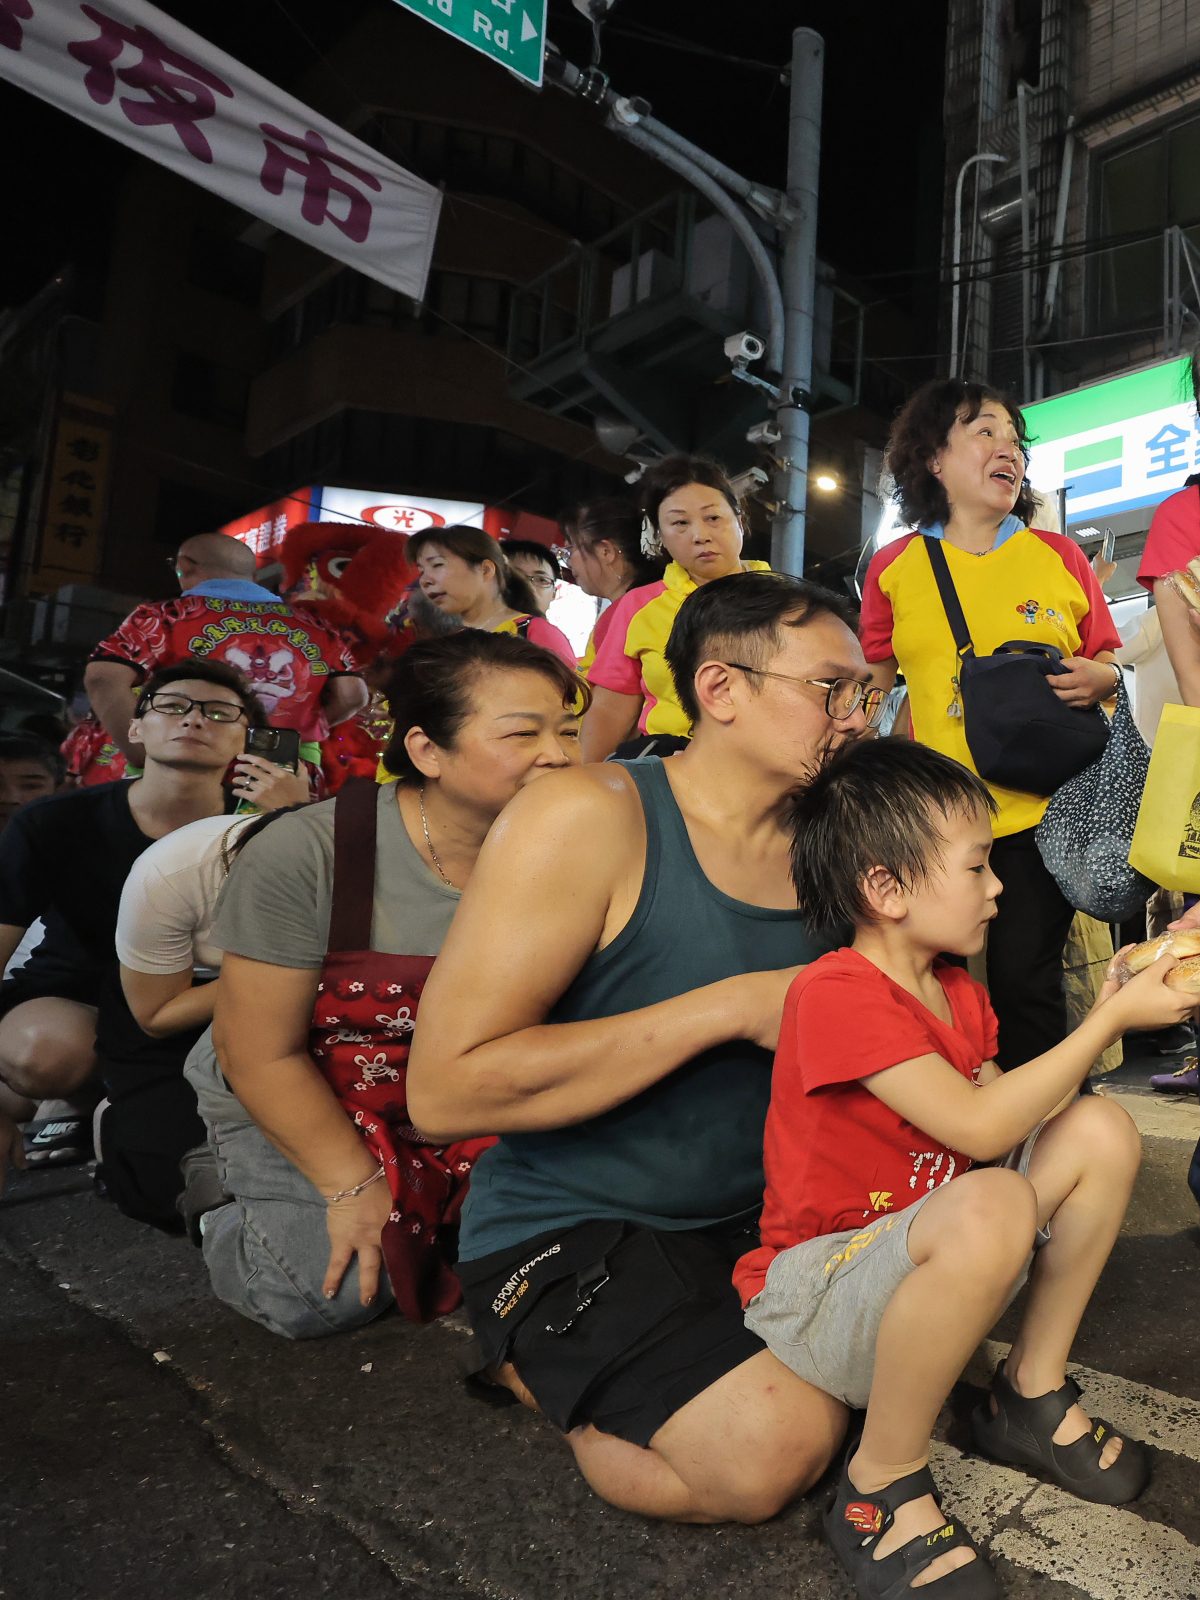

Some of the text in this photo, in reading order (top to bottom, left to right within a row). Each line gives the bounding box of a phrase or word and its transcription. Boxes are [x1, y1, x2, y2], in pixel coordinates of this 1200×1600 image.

[473, 10, 514, 54] Rd.
[393, 509, 415, 529] 光
[497, 1271, 521, 1301] POINT
[518, 1243, 562, 1277] KHAKIS
[499, 1294, 518, 1319] SINCE
